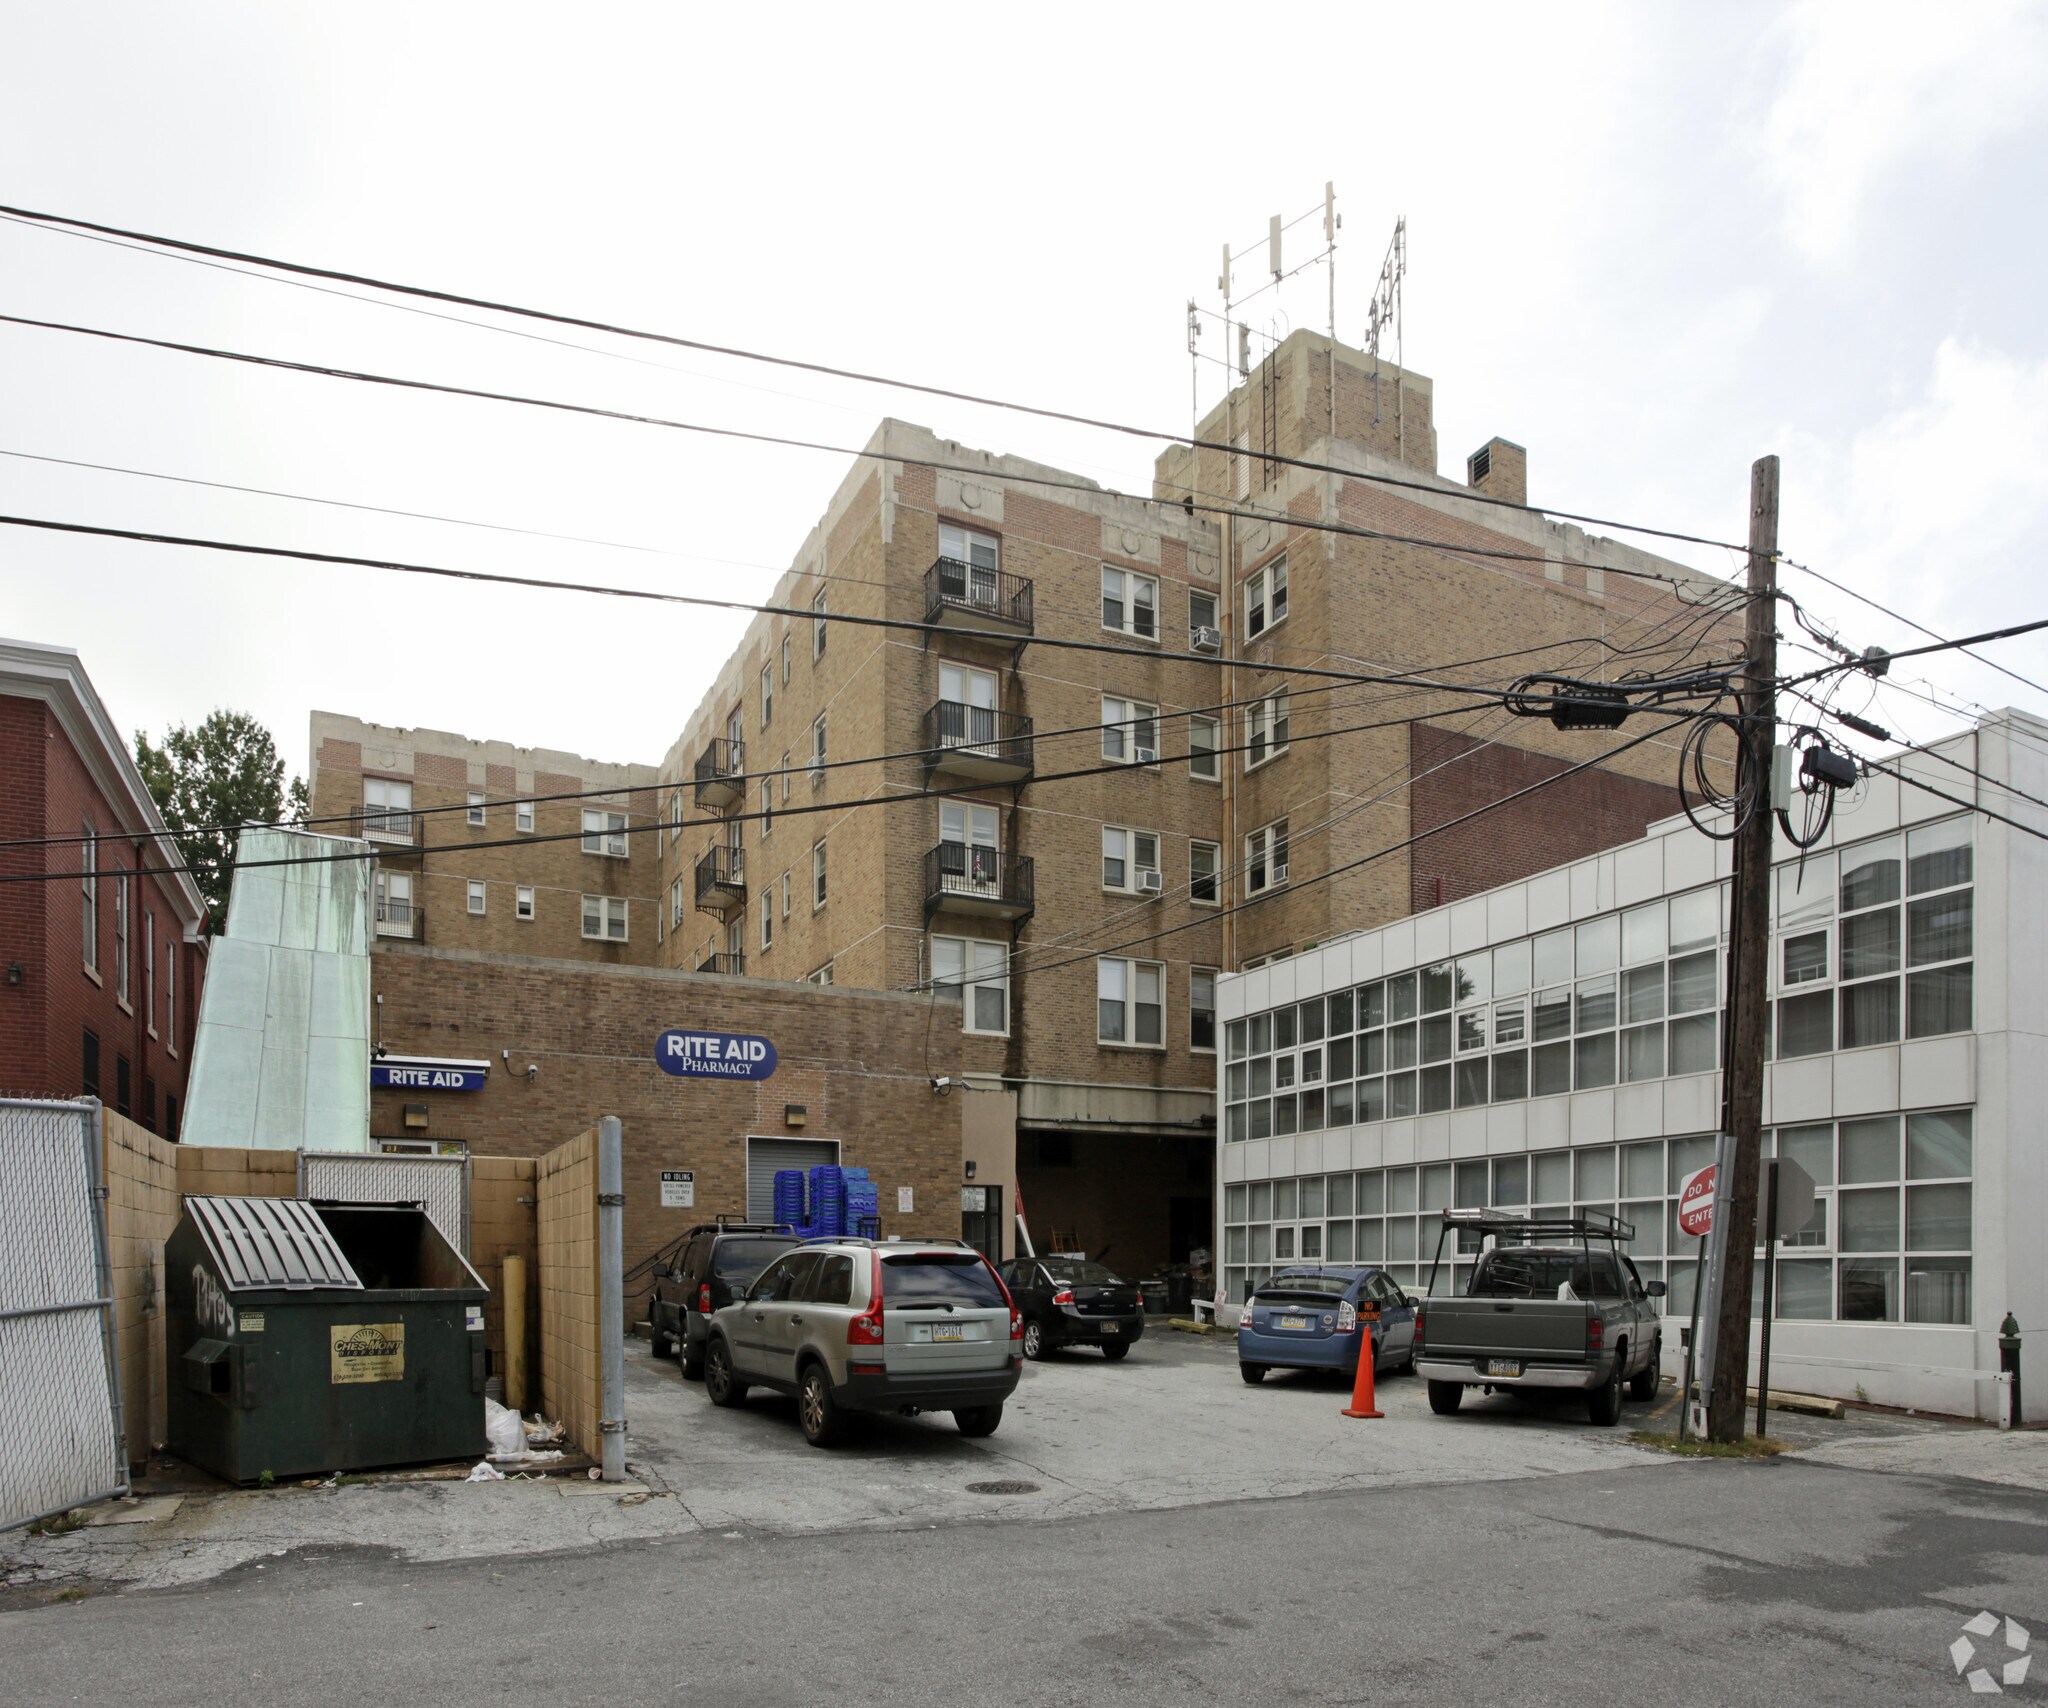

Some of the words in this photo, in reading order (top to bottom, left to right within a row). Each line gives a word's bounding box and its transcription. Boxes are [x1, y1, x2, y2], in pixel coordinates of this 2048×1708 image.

[667, 1035, 720, 1058] RITE
[724, 1039, 766, 1062] AID
[389, 1069, 430, 1086] RITE
[432, 1072, 464, 1087] AID
[673, 1173, 691, 1181] IDLING
[1688, 1183, 1702, 1197] DO
[1688, 1208, 1713, 1226] ENTE
[1364, 1302, 1373, 1311] NO
[1357, 1311, 1380, 1320] PARKING
